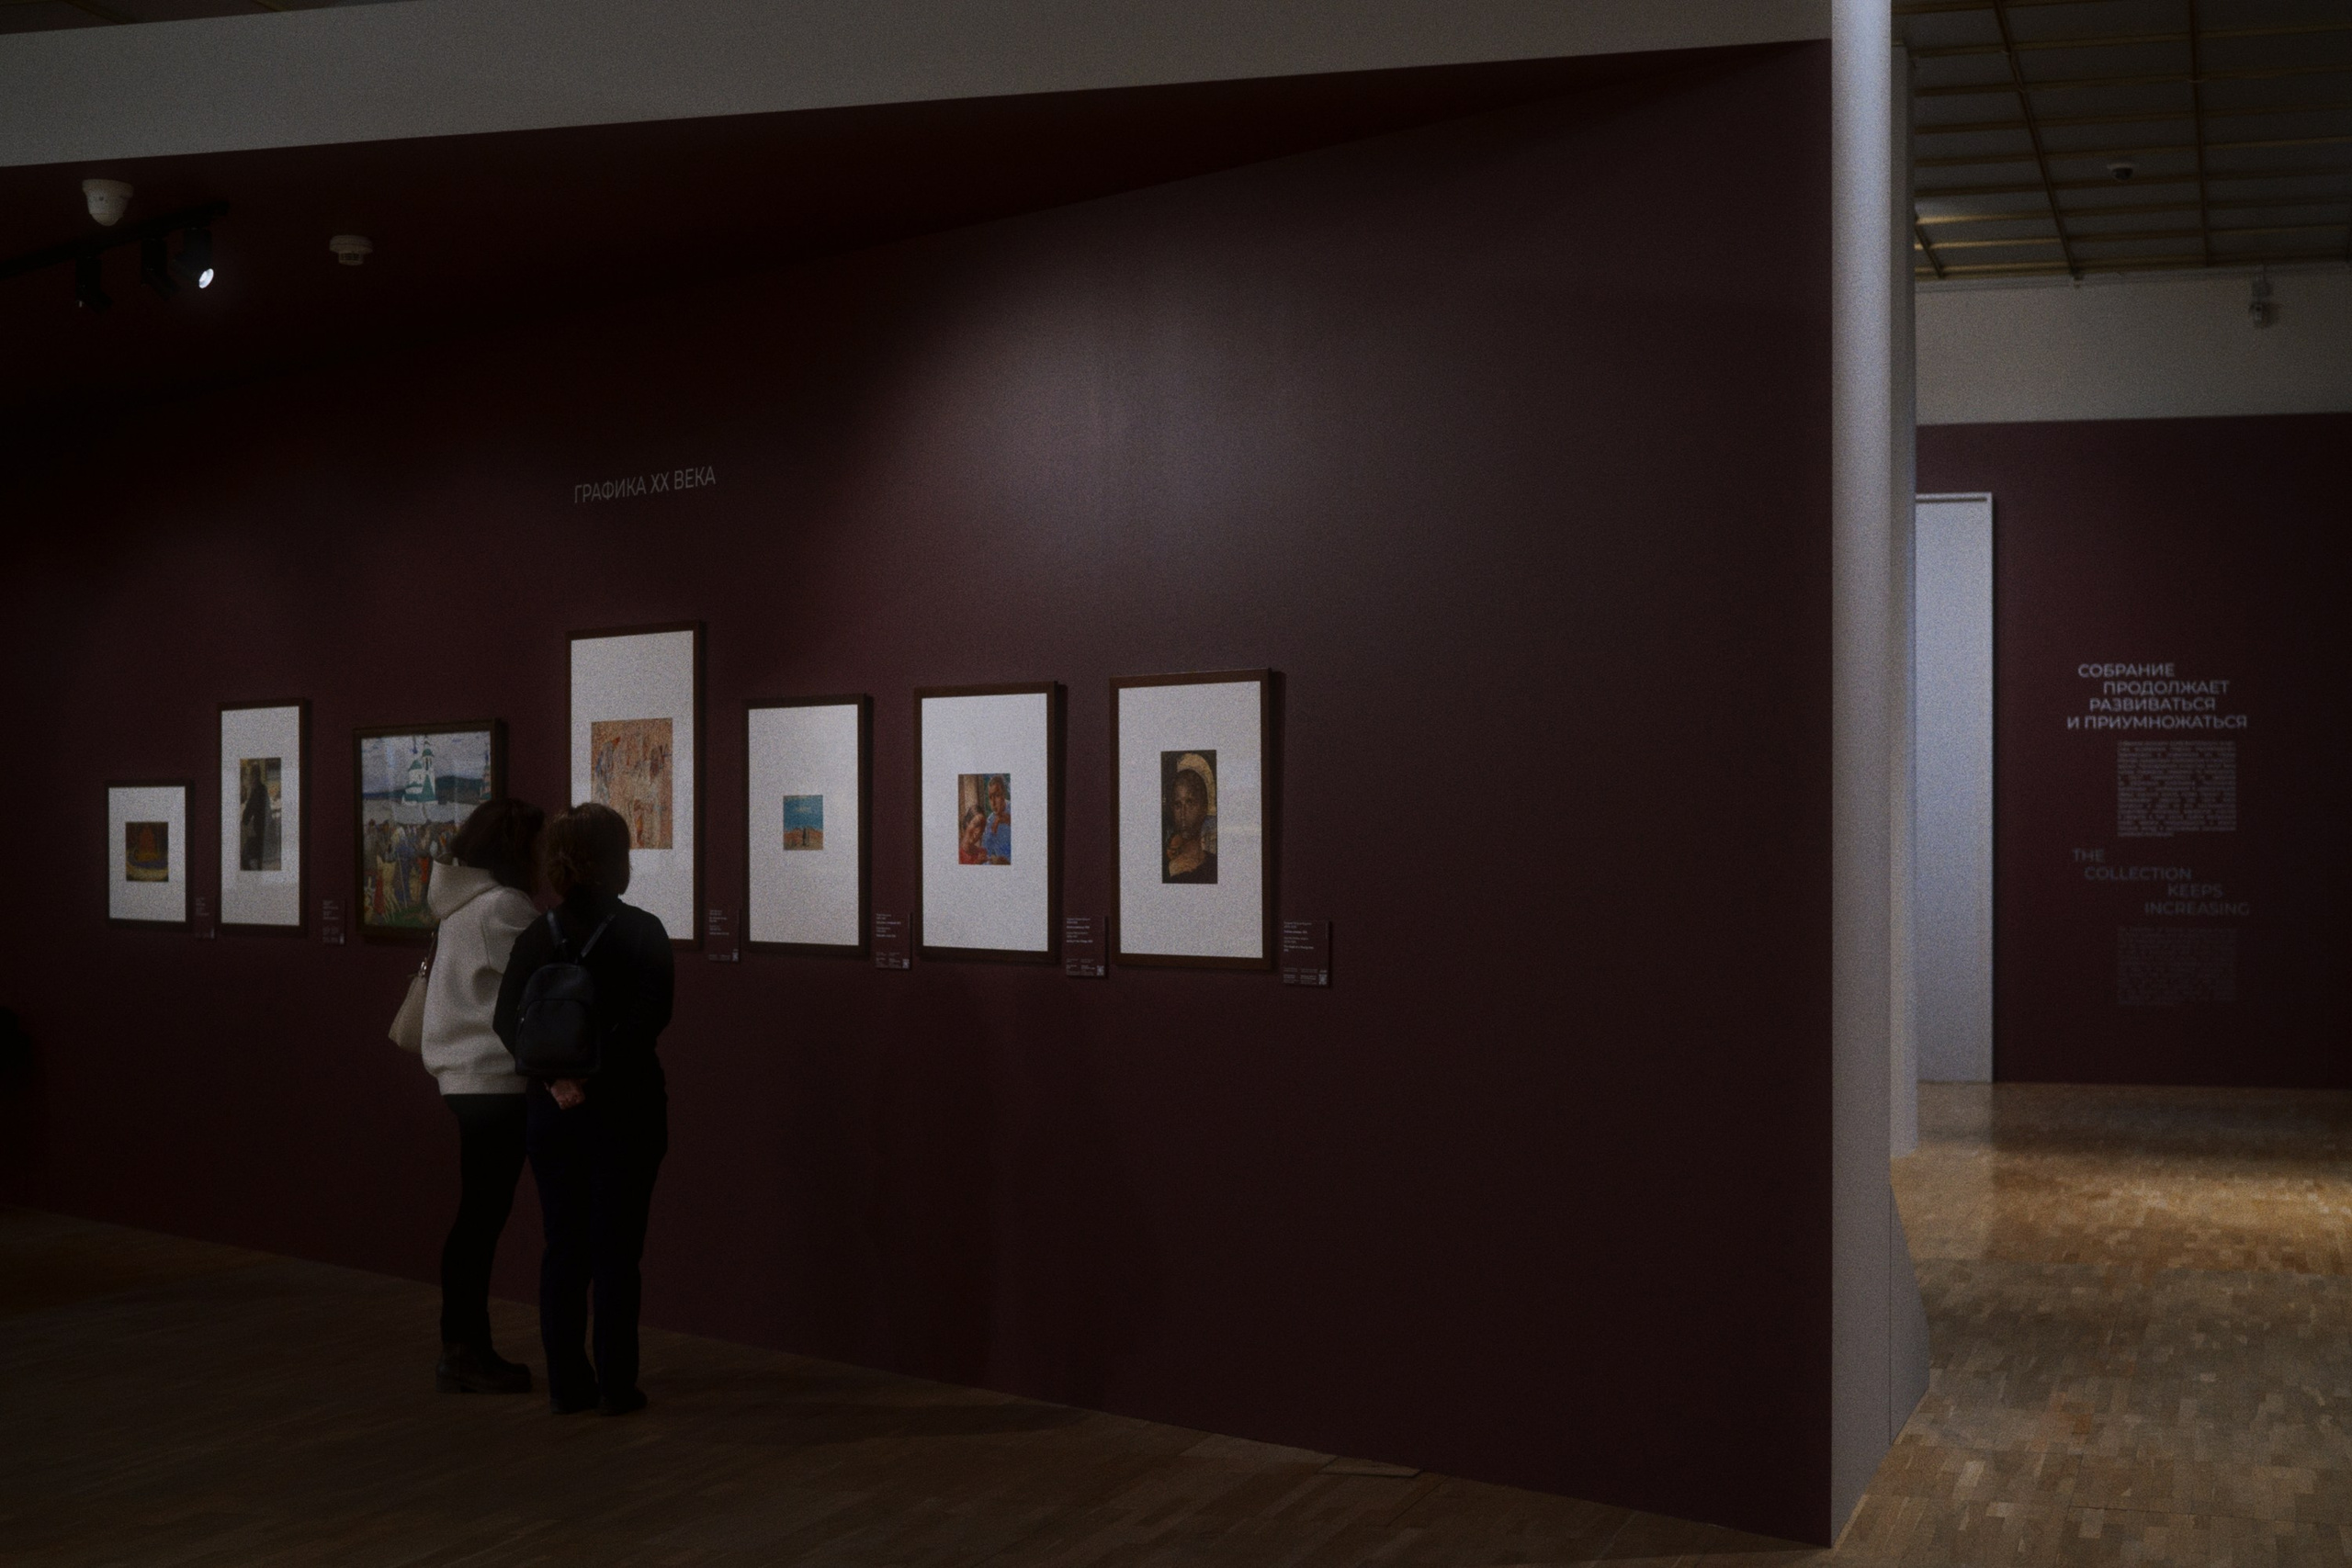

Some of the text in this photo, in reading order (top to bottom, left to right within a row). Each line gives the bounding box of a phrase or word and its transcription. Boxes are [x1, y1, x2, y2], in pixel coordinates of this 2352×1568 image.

[574, 475, 647, 503] ГРАФИКА
[673, 466, 717, 491] ВЕКА
[2077, 662, 2176, 679] СОБРАНИЕ
[2103, 680, 2230, 696] ПРОДОЛЖАЕТ
[2089, 697, 2216, 712] РАЗВИВАТЬСЯ
[2066, 715, 2248, 730] И ПРИУМНОЖАТЬСЯ
[2073, 848, 2105, 863] THE
[2084, 865, 2193, 881] COLLECTION
[2167, 883, 2224, 898] KEEPS
[2143, 901, 2250, 916] INCREASING
